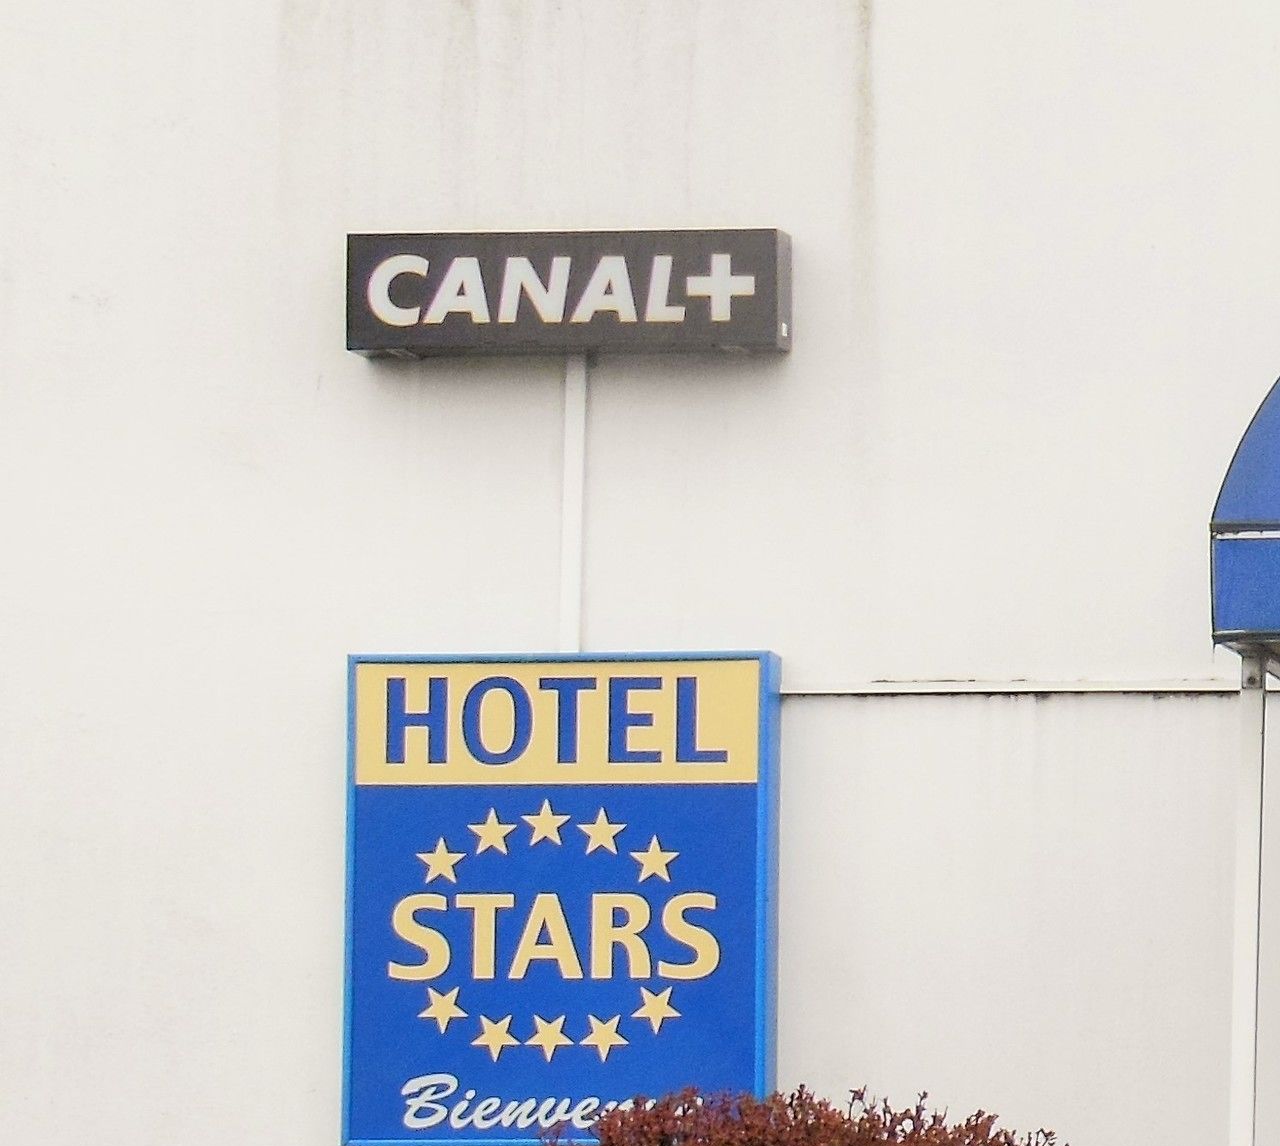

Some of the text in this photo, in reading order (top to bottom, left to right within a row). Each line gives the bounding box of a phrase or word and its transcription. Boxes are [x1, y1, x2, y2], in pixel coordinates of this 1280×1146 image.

[367, 252, 756, 327] CANAL+
[384, 675, 730, 765] HOTEL
[387, 891, 722, 981] STARS
[401, 1072, 704, 1130] Bienve
